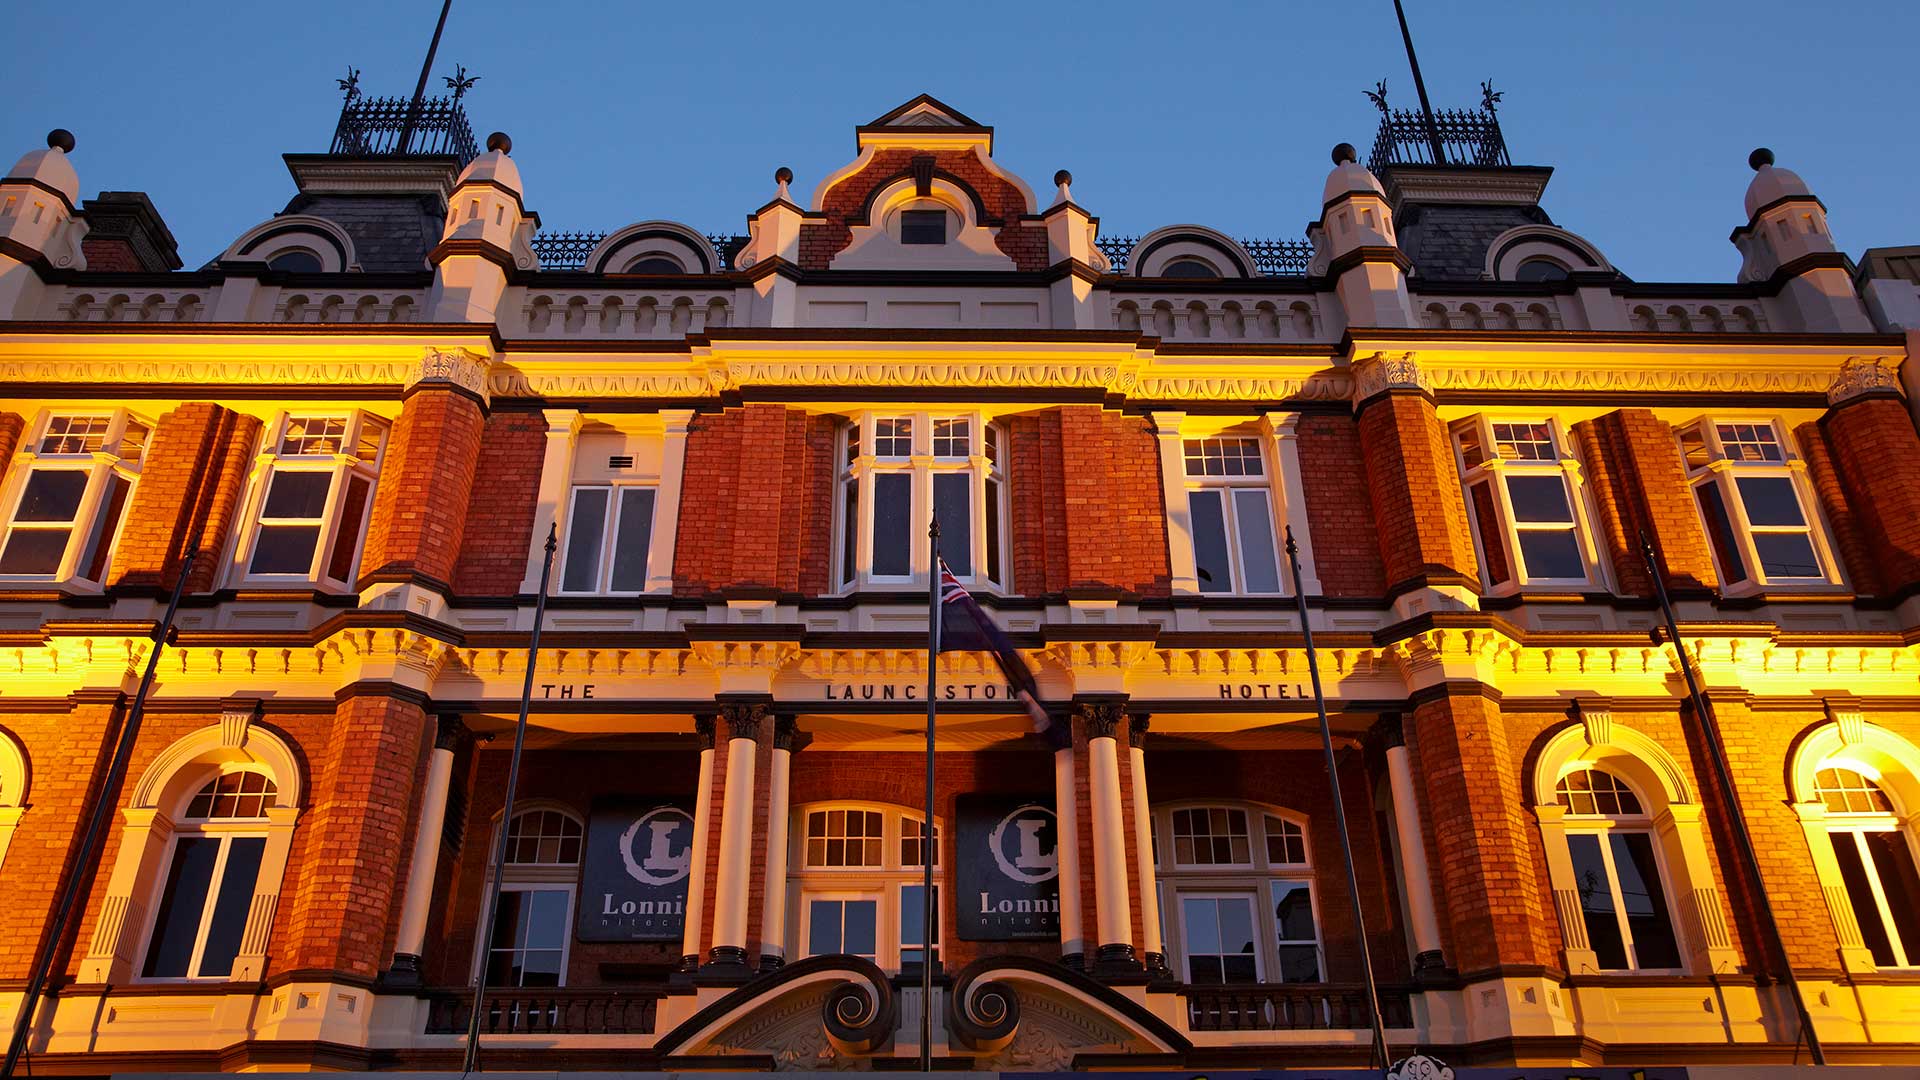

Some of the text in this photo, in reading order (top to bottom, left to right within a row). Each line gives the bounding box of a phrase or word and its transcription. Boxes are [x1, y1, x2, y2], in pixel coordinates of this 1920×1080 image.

[541, 684, 1309, 700] THE LAUNCSTON HOTEL
[602, 893, 683, 915] Lonni
[980, 892, 1059, 913] Lonni
[602, 918, 681, 927] nitecl
[981, 916, 1059, 925] nitecl
